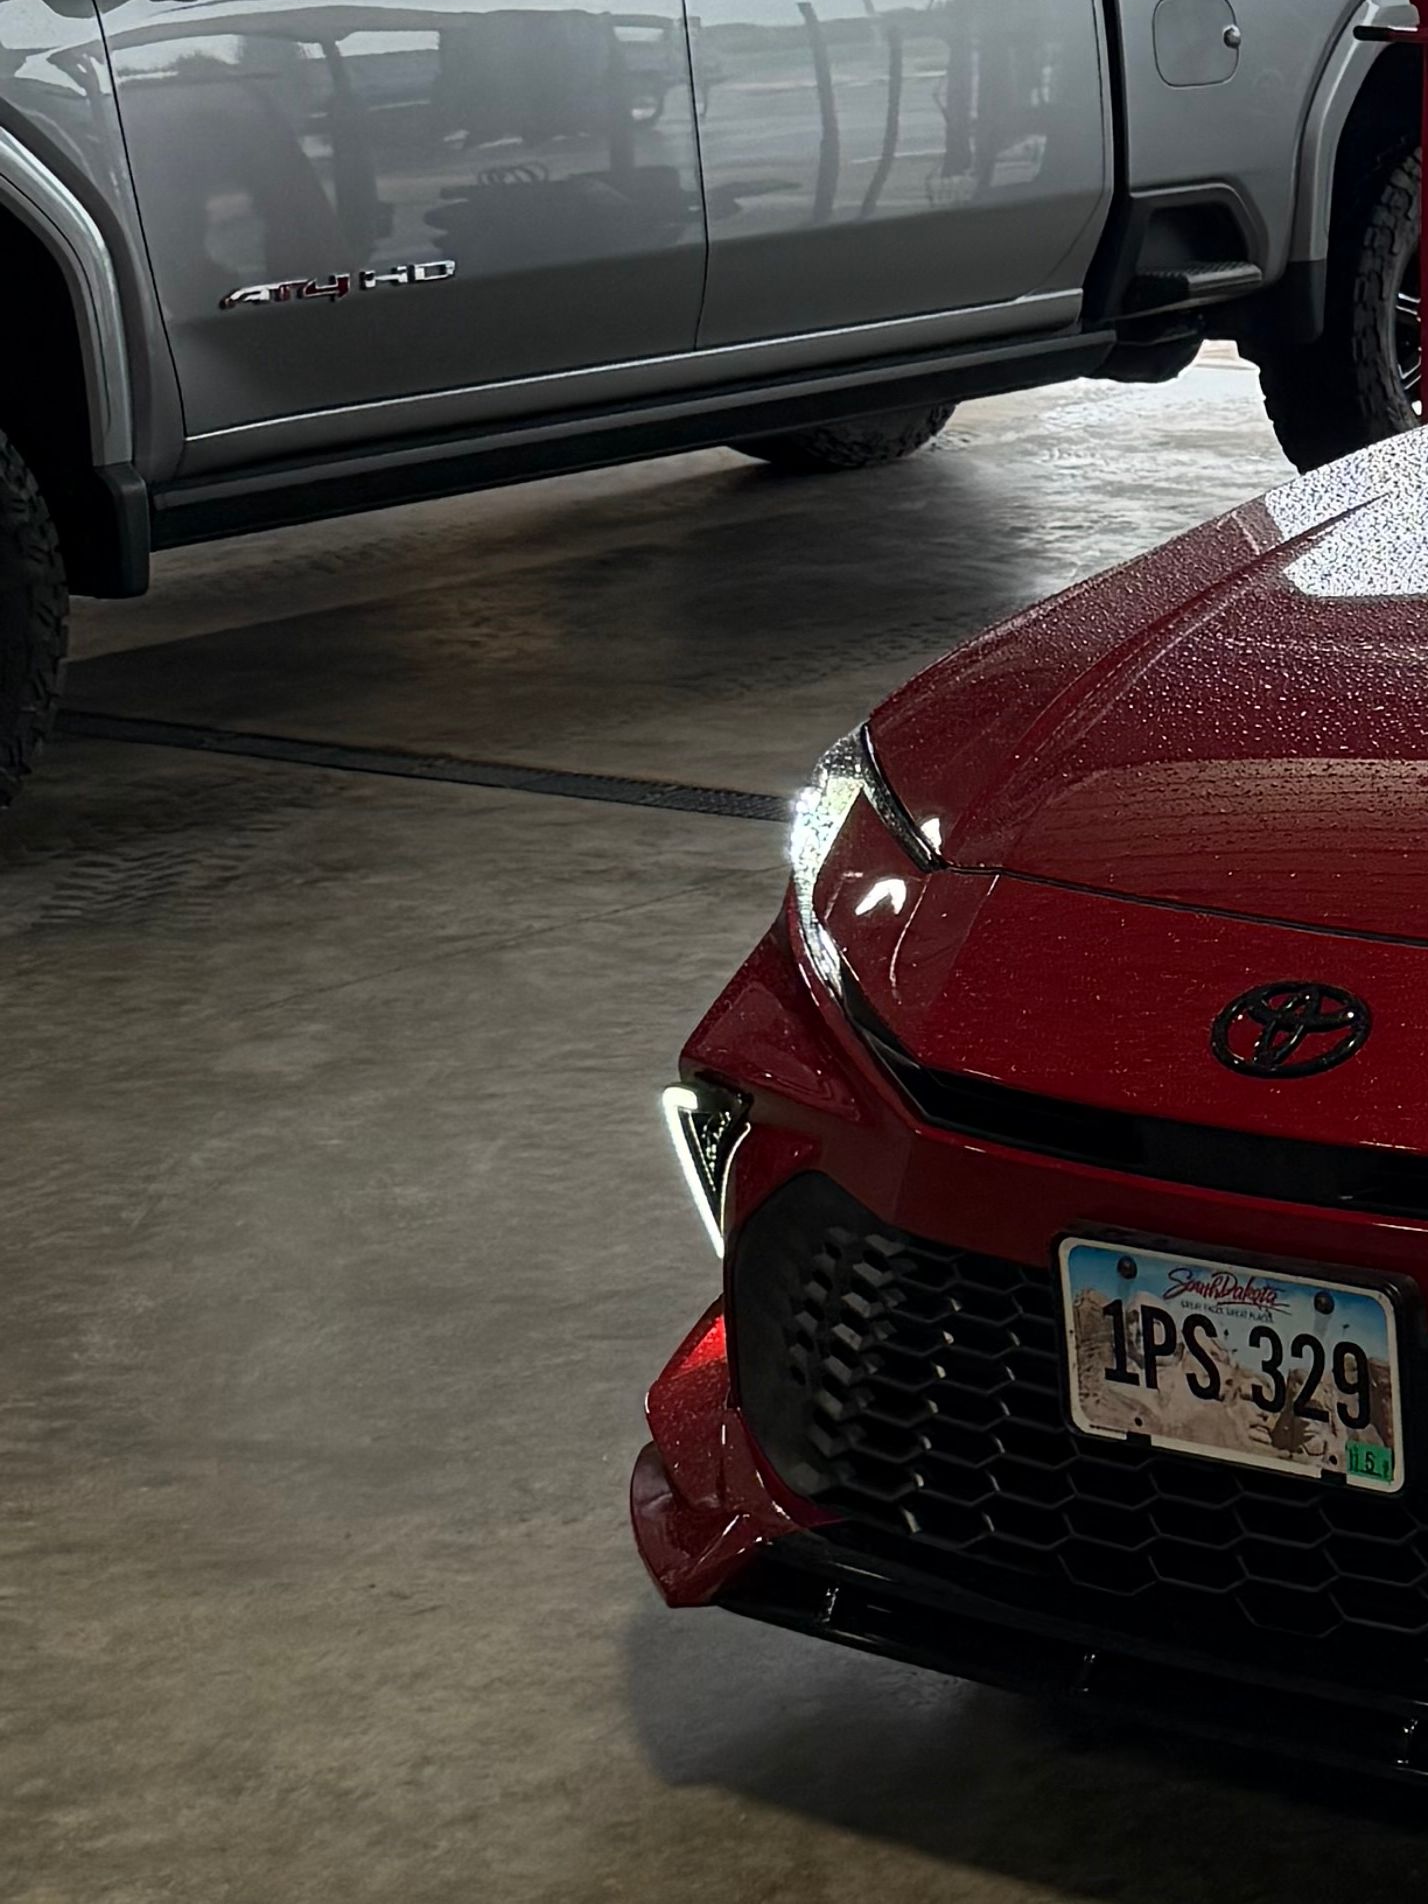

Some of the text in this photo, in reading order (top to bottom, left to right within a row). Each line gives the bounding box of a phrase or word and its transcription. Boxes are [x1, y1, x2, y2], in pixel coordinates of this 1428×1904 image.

[219, 260, 456, 307] AT4 HD
[1102, 1299, 1371, 1429] 1PS 329
